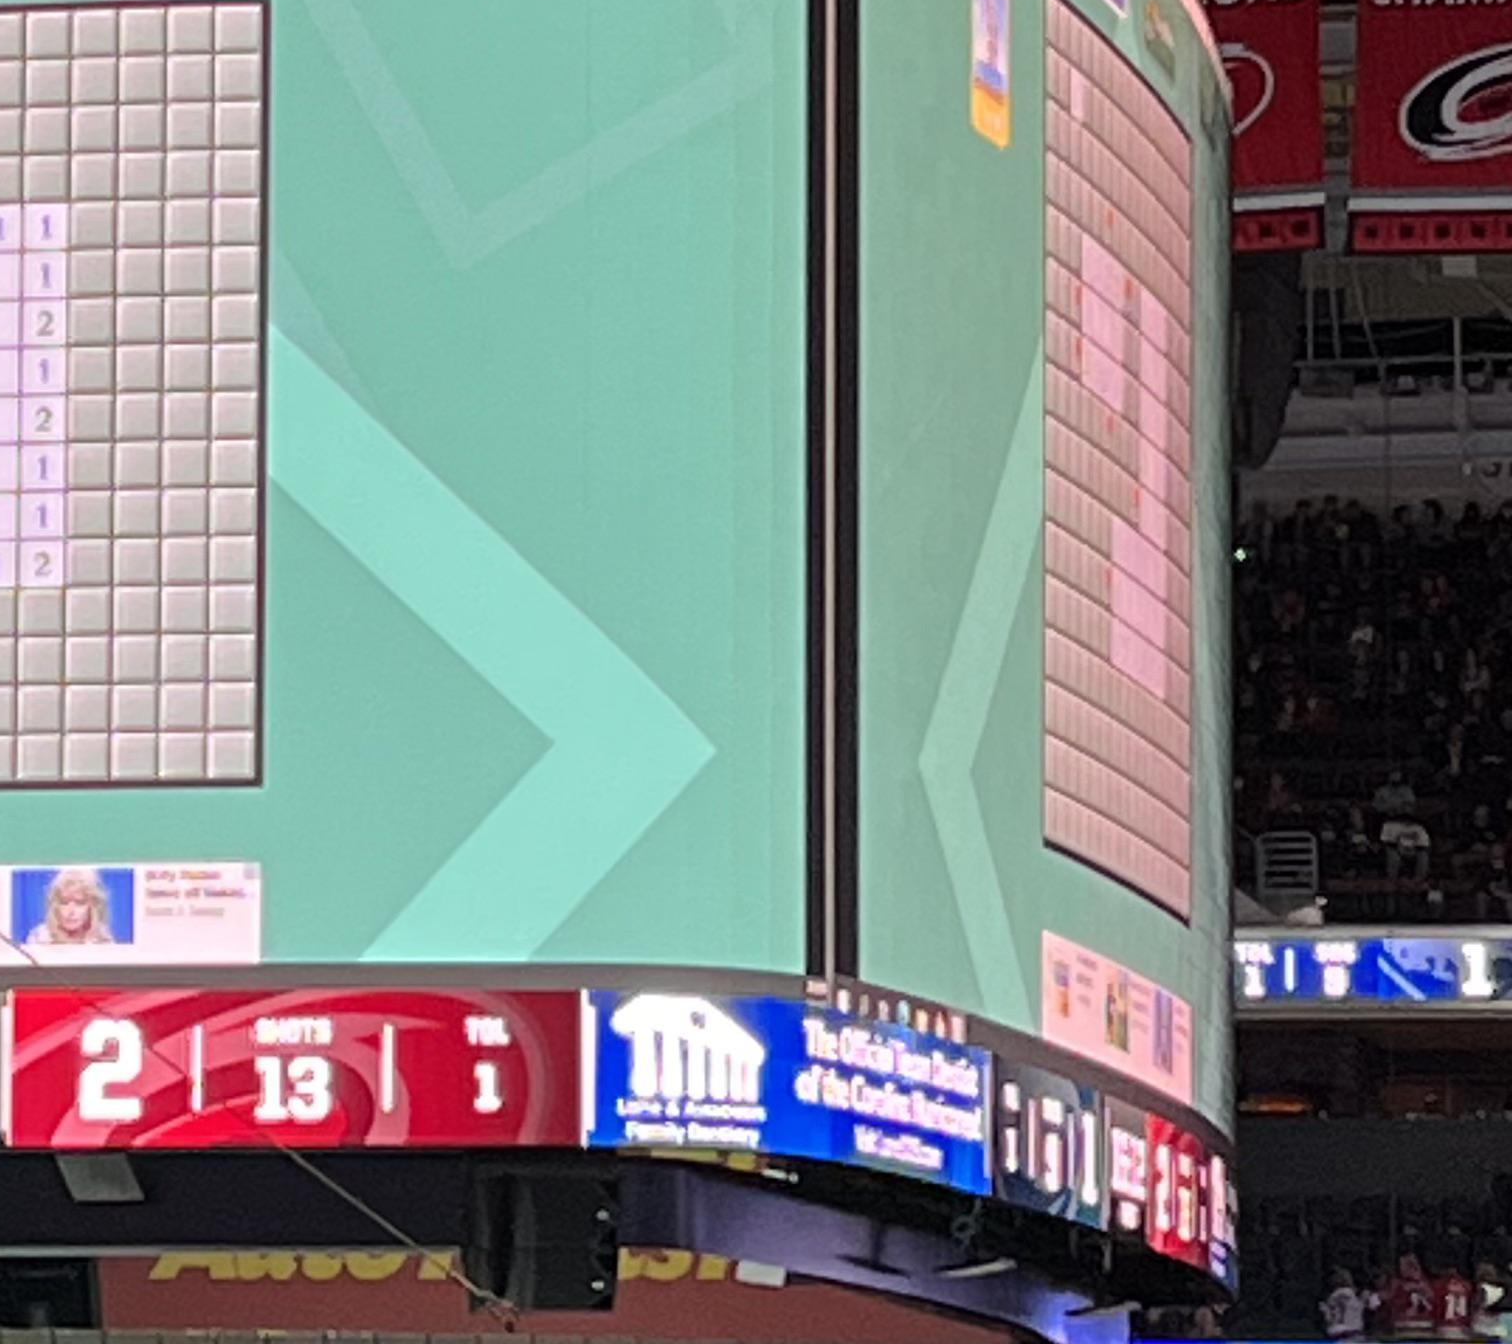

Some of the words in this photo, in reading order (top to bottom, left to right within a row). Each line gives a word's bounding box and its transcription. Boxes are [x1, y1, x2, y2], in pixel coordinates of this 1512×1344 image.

[40, 214, 53, 241] 1
[39, 262, 53, 290] 1
[36, 309, 55, 337] 2
[38, 357, 51, 385] 1
[34, 405, 54, 433] 2
[37, 454, 50, 481] 1
[36, 502, 49, 529] 1
[33, 551, 53, 578] 2
[80, 1019, 142, 1122] 2
[254, 1056, 331, 1120] 13
[473, 1064, 502, 1112] 1
